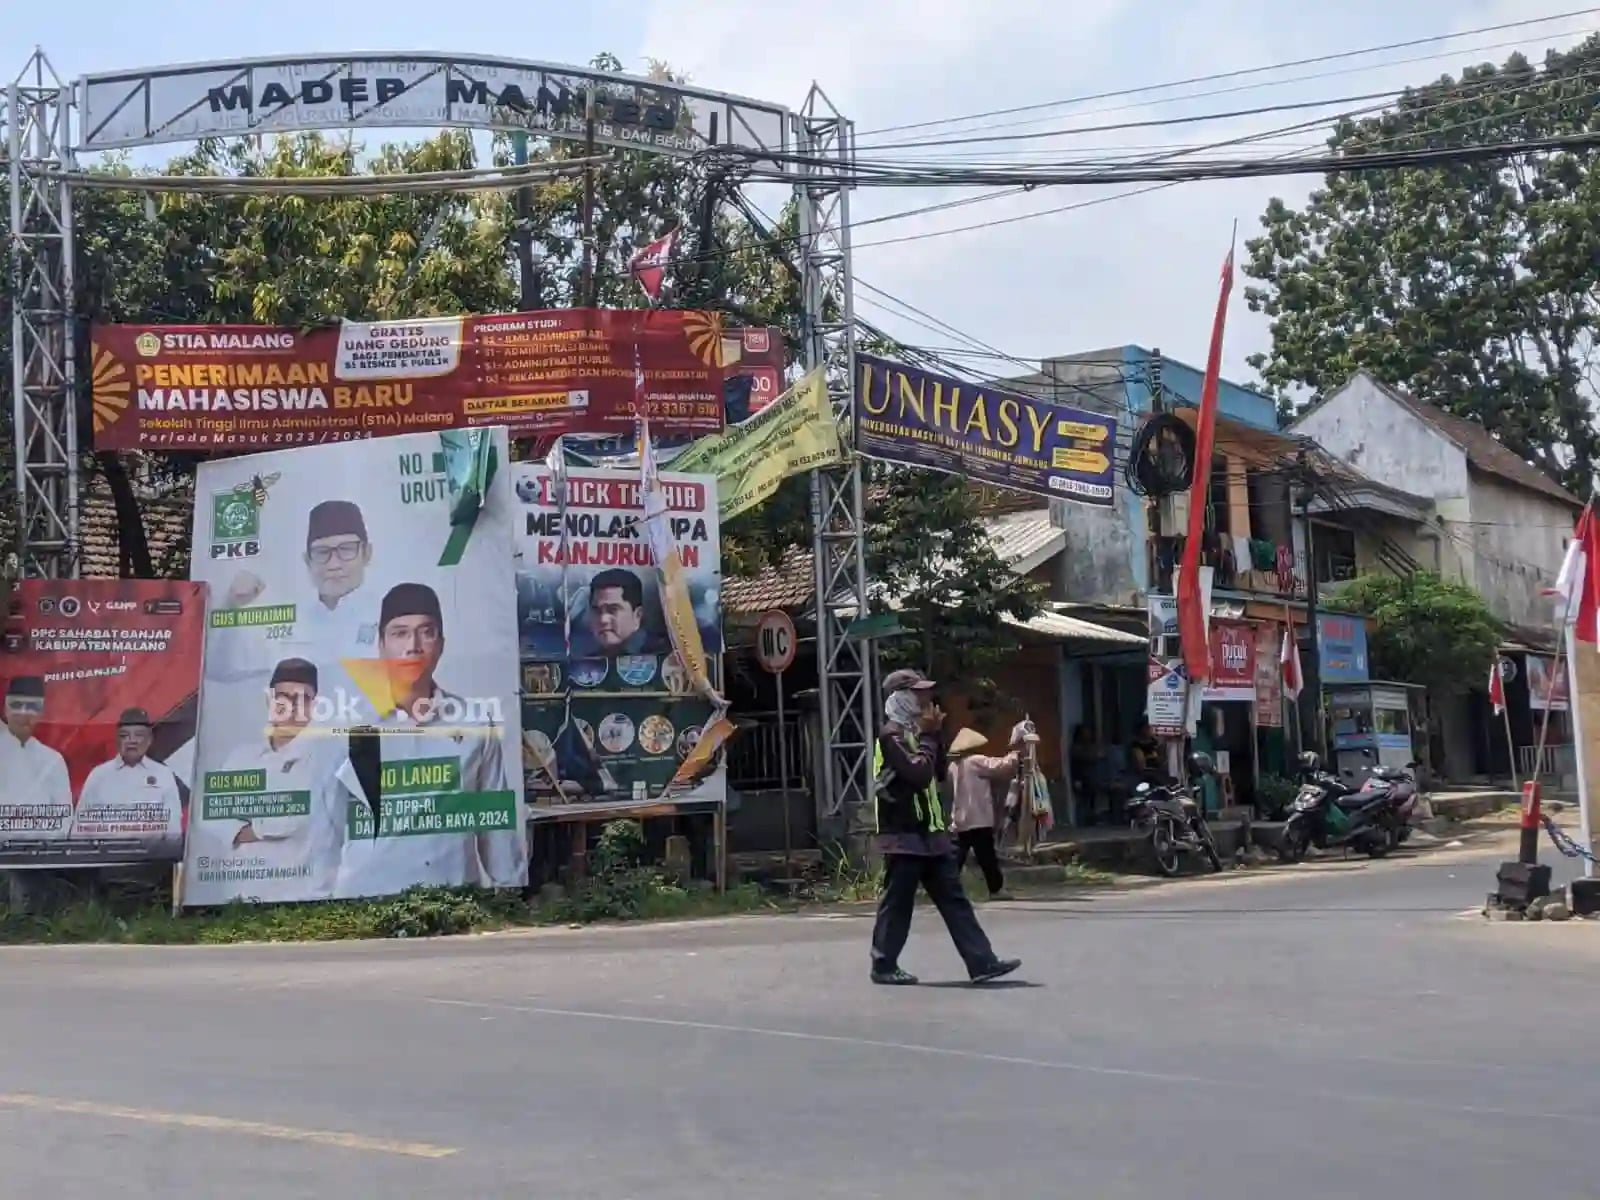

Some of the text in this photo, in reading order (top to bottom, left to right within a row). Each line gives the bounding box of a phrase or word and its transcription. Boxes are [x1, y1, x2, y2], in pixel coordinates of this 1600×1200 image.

[208, 77, 405, 112] MADEP
[370, 326, 424, 338] GRATIS
[473, 321, 525, 333] PROGRAM
[164, 333, 295, 348] STIA MALANG
[345, 336, 450, 351] UANG GEDUNG
[381, 348, 441, 359] PENDAFTAR
[136, 361, 329, 387] PENERIMAAN
[137, 383, 413, 411] MAHASISWA BARU
[467, 399, 507, 410] DAFTAR
[861, 363, 1053, 453] UNHASY
[139, 416, 192, 429] Sekolah
[195, 416, 237, 431] Tinggi
[240, 416, 269, 428] Ilmu
[272, 415, 359, 428] Administrasi
[362, 412, 401, 428] (STIA)
[404, 412, 454, 425] Malang
[213, 432, 269, 443] Masuk
[400, 452, 422, 475] NO
[401, 479, 446, 504] URUT
[617, 482, 698, 508] THHIR
[526, 511, 640, 538] MENOLAK
[210, 541, 259, 559] PKB
[213, 611, 233, 626] GUS
[59, 629, 118, 639] SAHABAT
[120, 629, 172, 640] GANJAR
[35, 640, 167, 651] KABUPATEN MALANG
[209, 775, 231, 789] GUS
[402, 764, 452, 787] LANDE
[396, 798, 436, 818] DPR-RI
[392, 814, 442, 832] MALANG
[446, 812, 475, 829] RAYA
[479, 810, 509, 826] 2024
